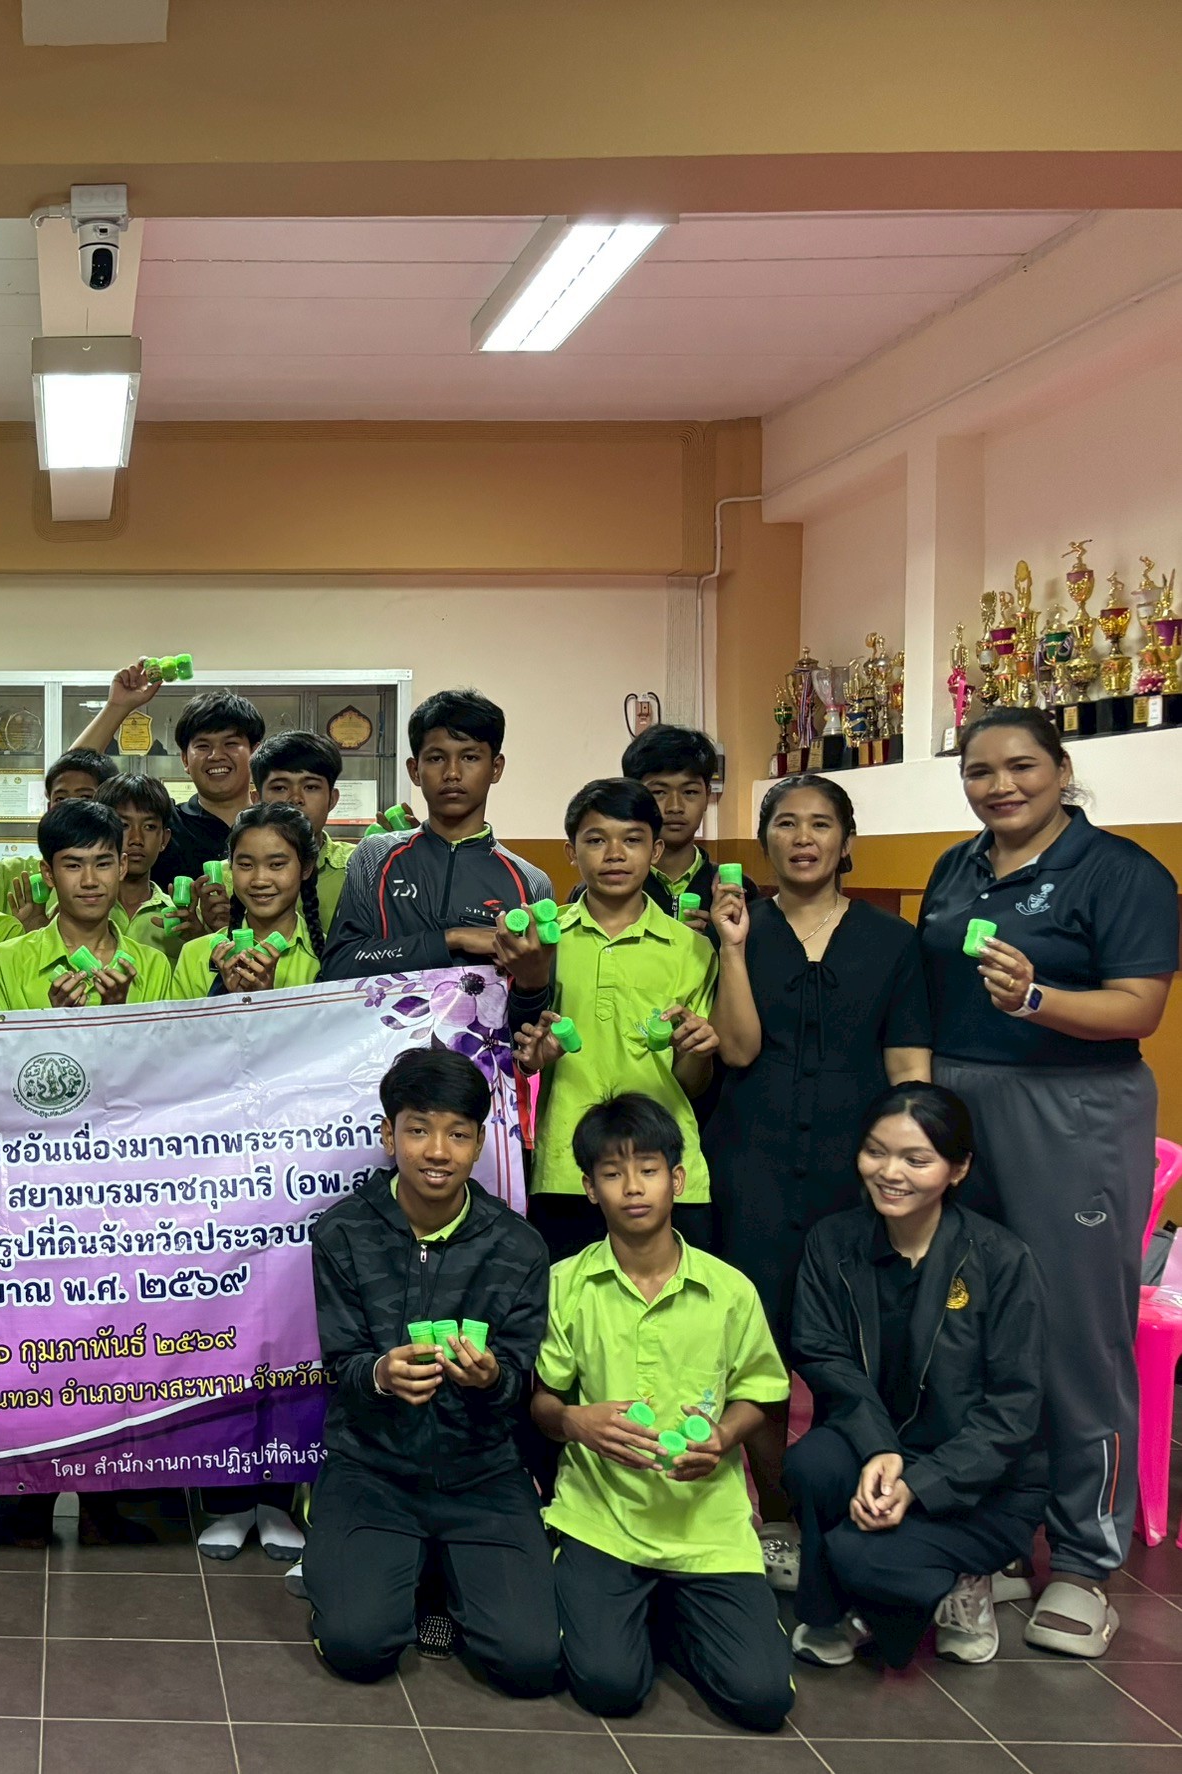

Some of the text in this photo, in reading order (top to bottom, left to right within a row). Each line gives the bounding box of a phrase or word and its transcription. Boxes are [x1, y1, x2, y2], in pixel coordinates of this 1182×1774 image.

[8, 1165, 273, 1210] สยามบรมราชกุมารี
[64, 1276, 126, 1301] พ.ศ.
[138, 1266, 247, 1298] ๒๕๖๙
[21, 1325, 147, 1372] กุมภาพันธ์
[155, 1328, 236, 1354] ๒๕๖๙
[61, 1374, 244, 1404] อำเภอบางสะพาน
[51, 1458, 86, 1477] โดย
